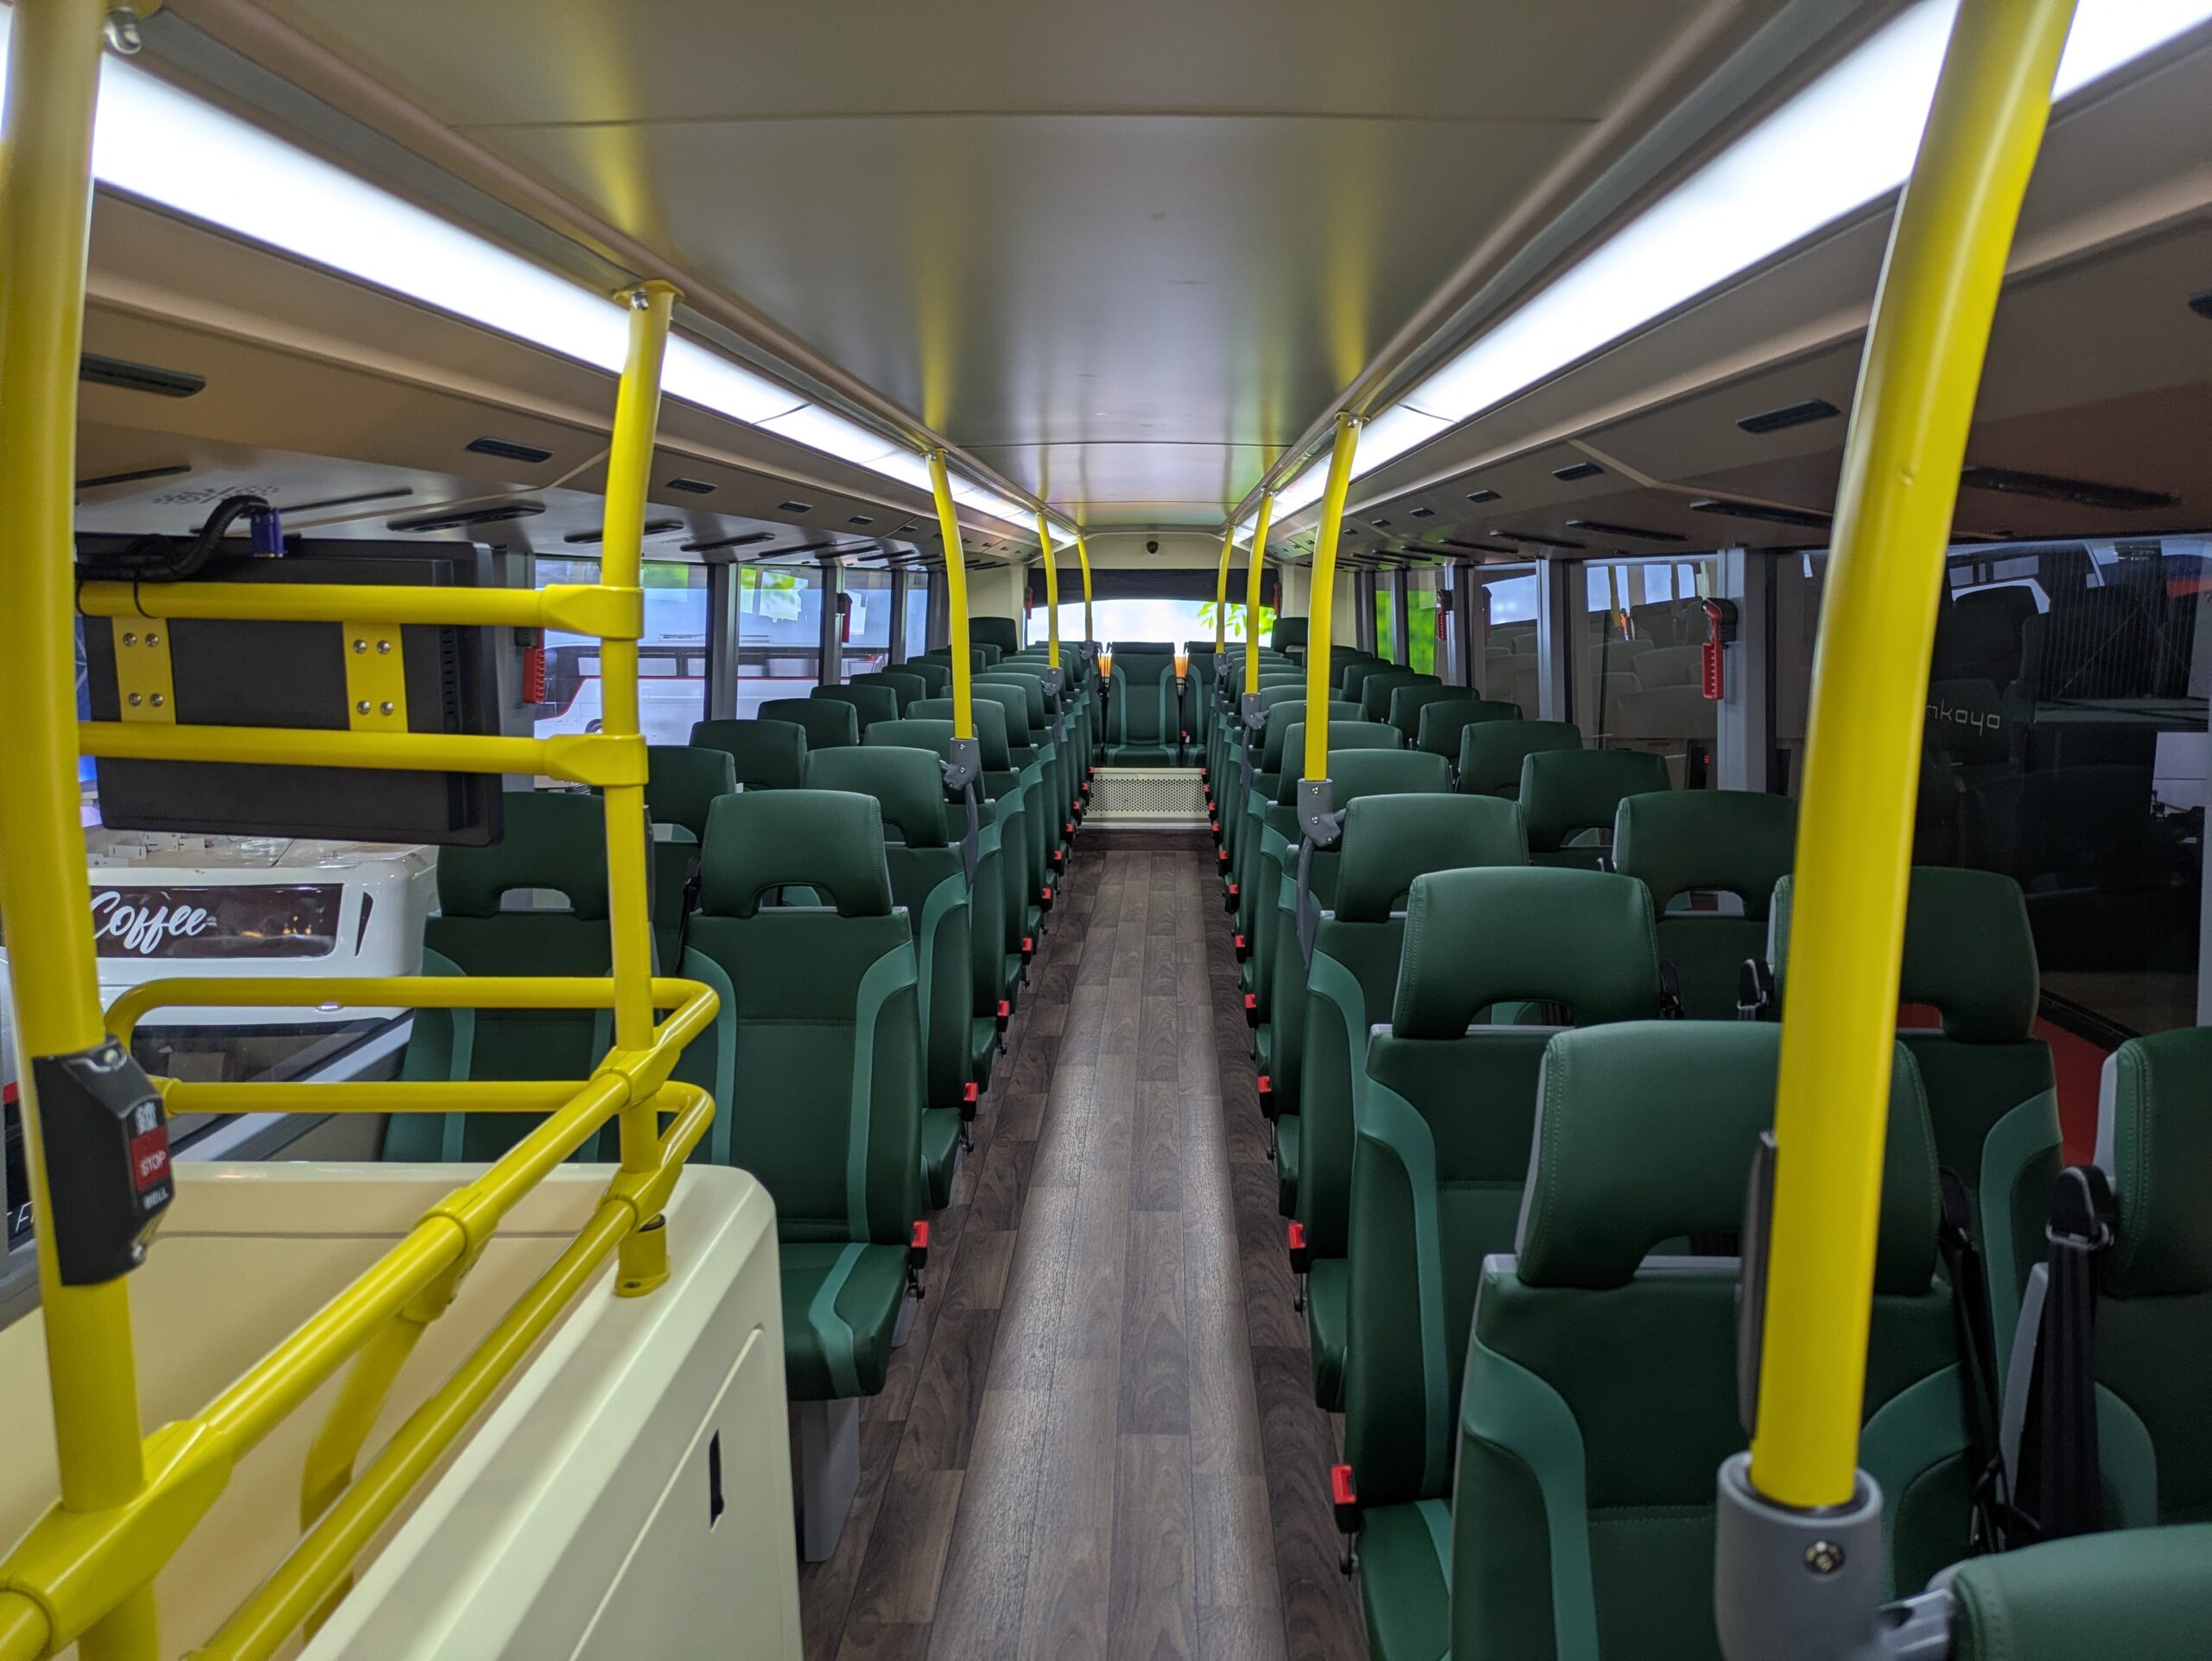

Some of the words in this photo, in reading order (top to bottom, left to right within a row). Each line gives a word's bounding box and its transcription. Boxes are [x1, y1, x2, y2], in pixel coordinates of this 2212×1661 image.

[90, 891, 207, 954] Coffee
[139, 1149, 167, 1177] STOP
[143, 1187, 169, 1211] BELL
